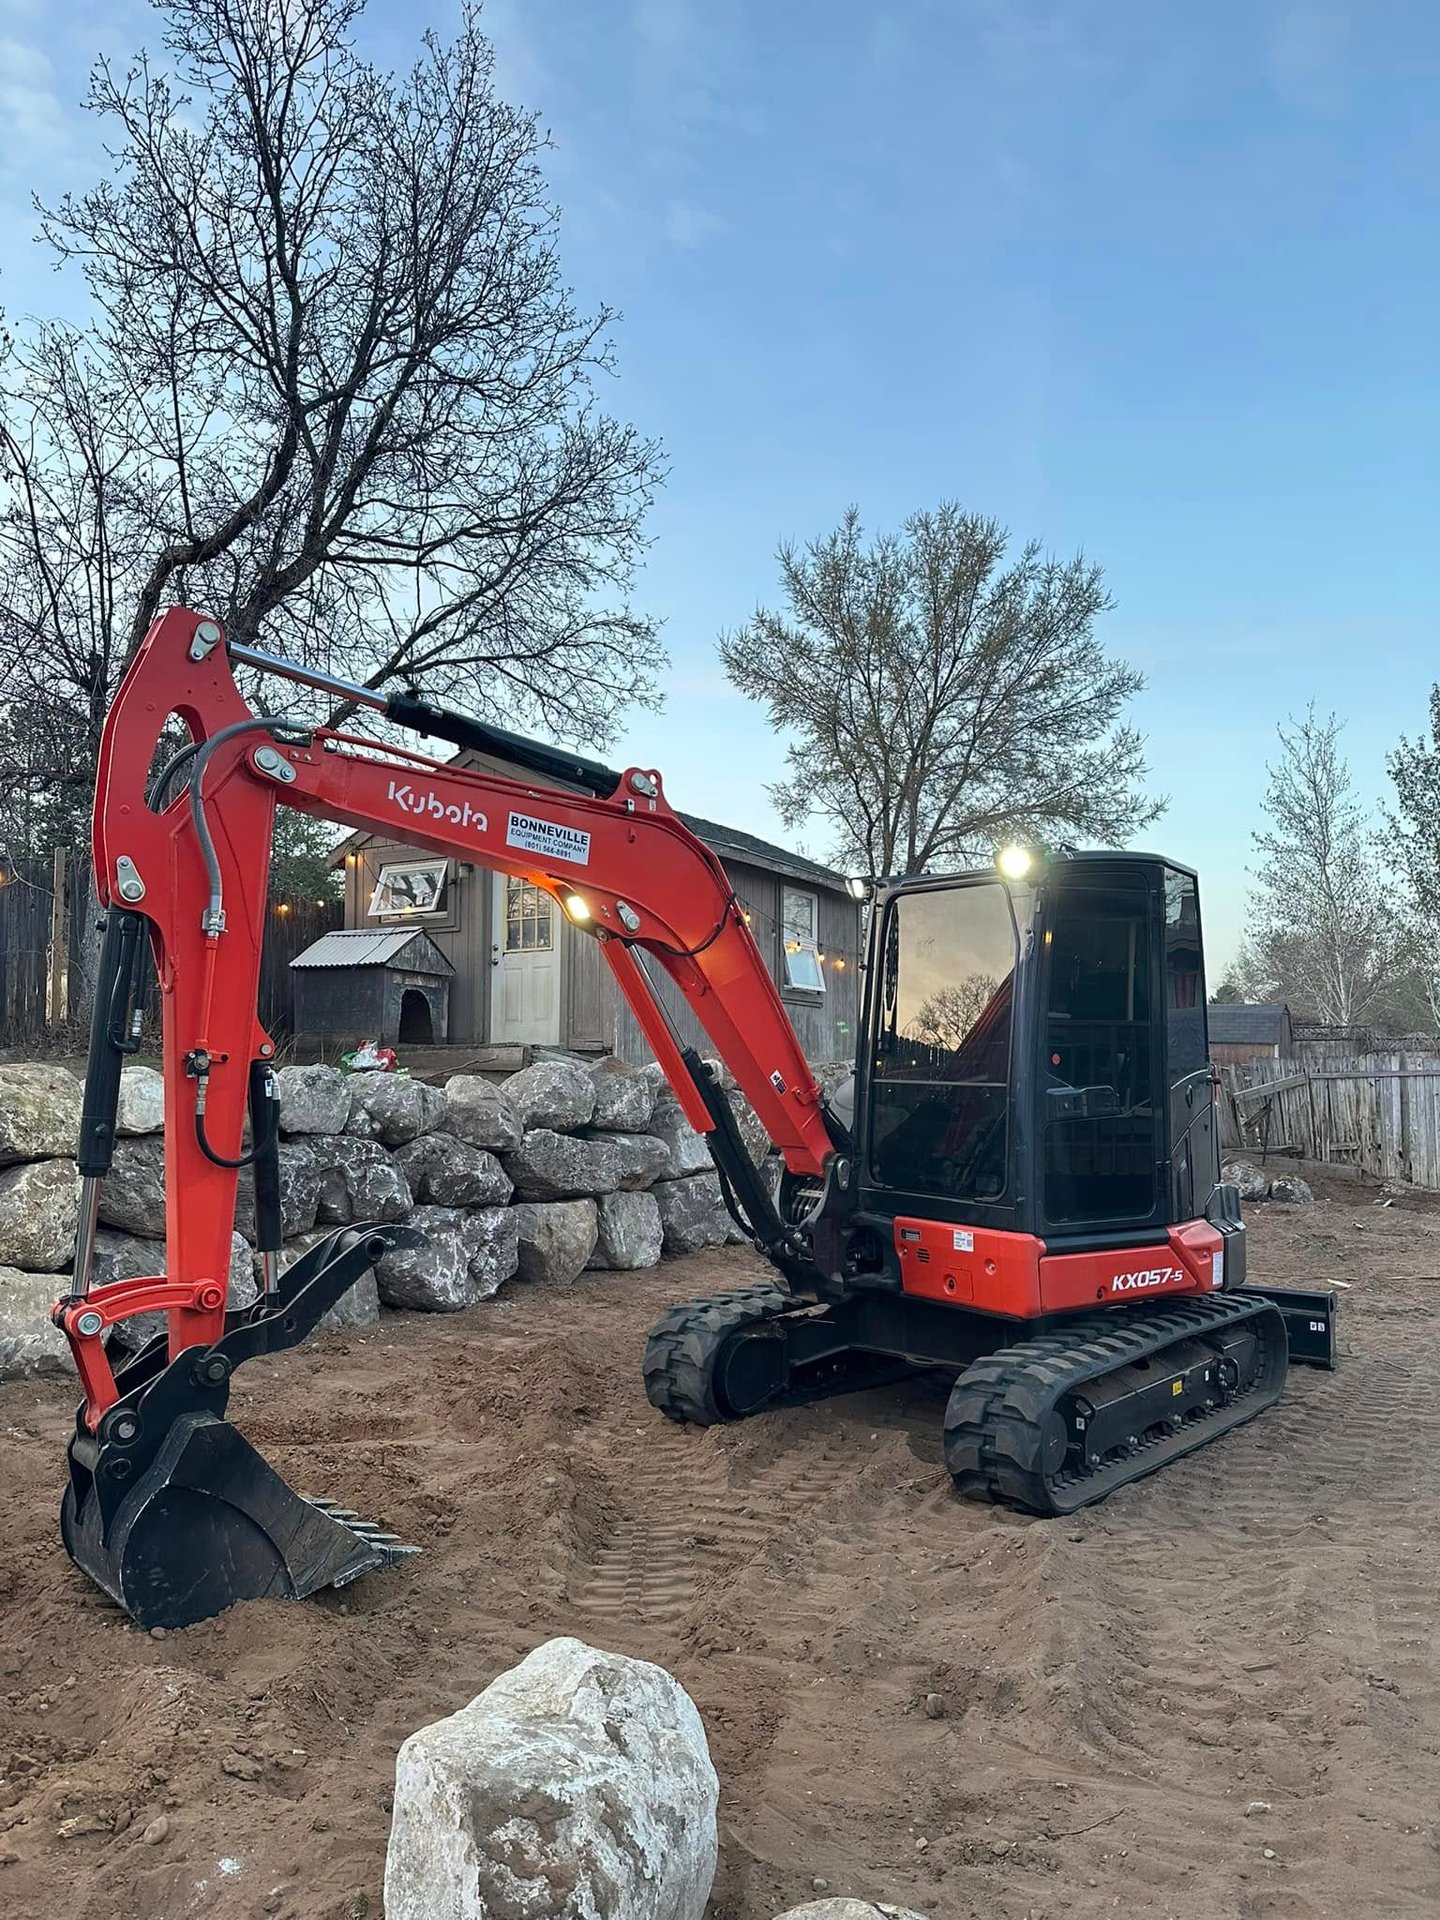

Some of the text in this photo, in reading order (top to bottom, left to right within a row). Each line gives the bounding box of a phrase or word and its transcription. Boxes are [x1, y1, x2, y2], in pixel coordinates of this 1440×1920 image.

[388, 781, 488, 832] Kubota
[511, 816, 588, 845] BONNEVILLE
[511, 828, 587, 853] EQUIPMENT COMPANY
[1112, 1267, 1183, 1291] KX057-5
